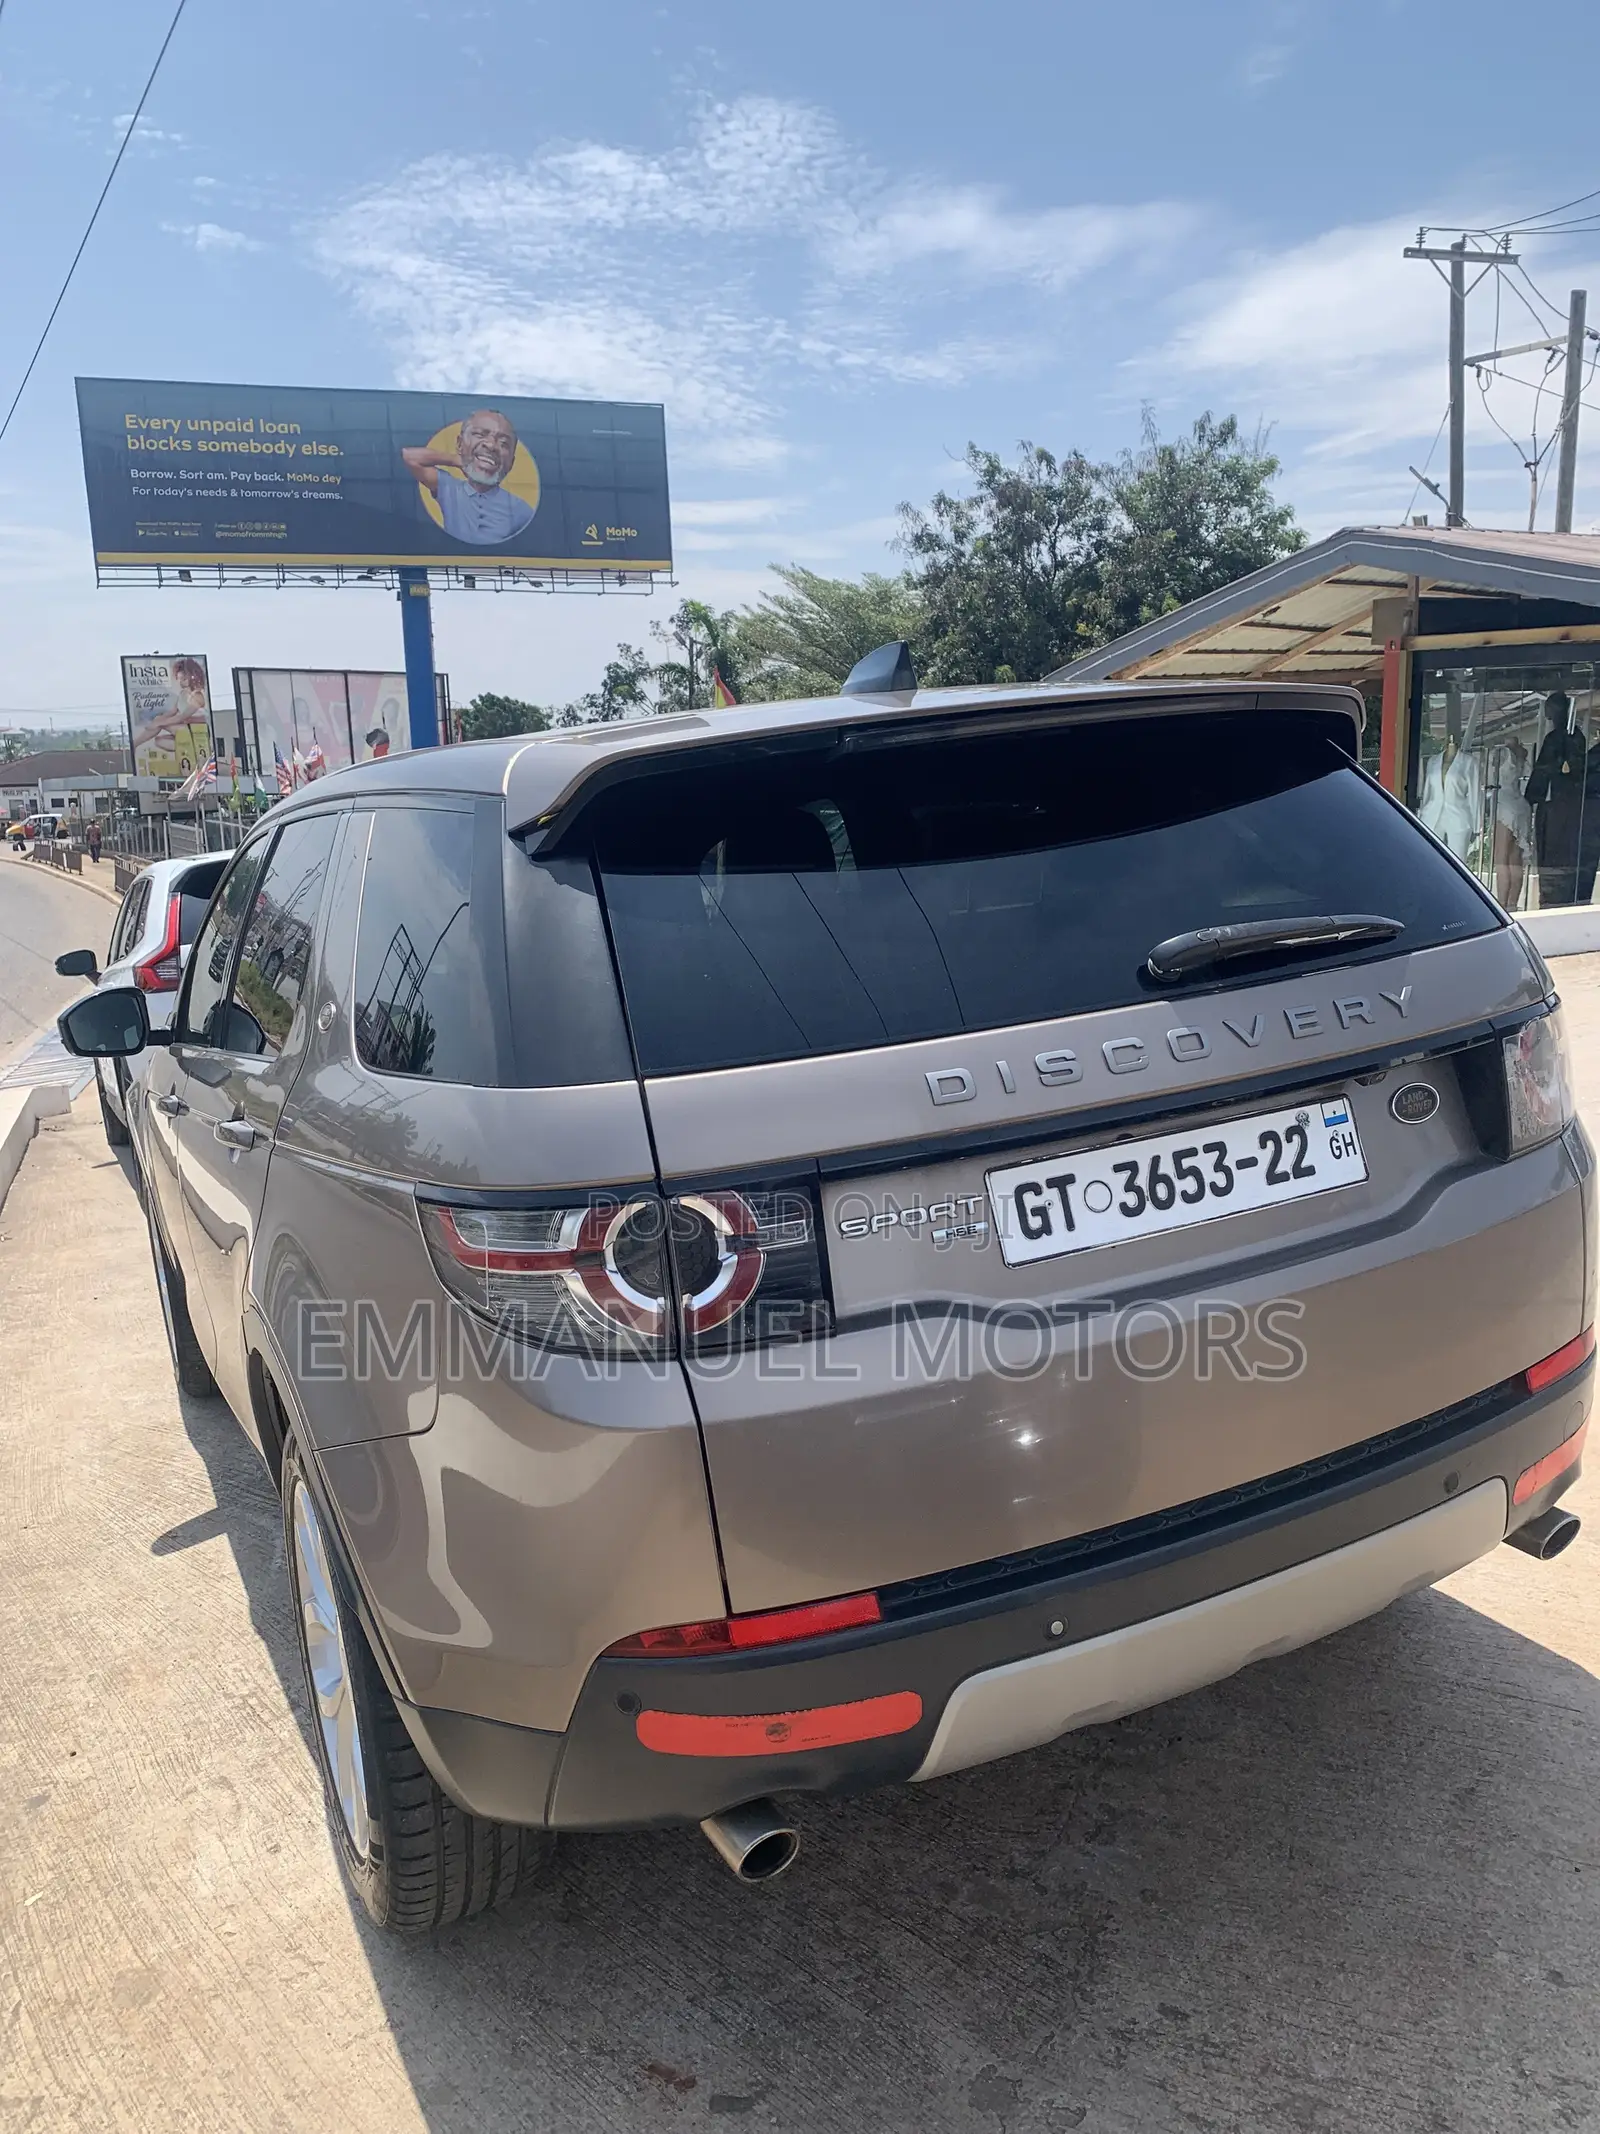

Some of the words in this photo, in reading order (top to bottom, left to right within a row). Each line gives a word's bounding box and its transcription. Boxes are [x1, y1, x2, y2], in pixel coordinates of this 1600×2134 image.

[125, 414, 181, 434] Every
[187, 417, 254, 435] unpaid
[260, 419, 301, 434] loan
[127, 434, 192, 451] blocks
[197, 438, 296, 458] somebody
[302, 441, 344, 456] else.
[130, 469, 177, 479] Borrow.
[180, 470, 204, 480] Sort
[206, 471, 228, 480] am.
[230, 471, 252, 482] Pay
[254, 472, 285, 481] back.
[287, 473, 320, 482] MoMo
[322, 474, 342, 485] dey
[132, 486, 151, 495] For
[154, 487, 193, 498] today's
[195, 488, 228, 497] needs
[230, 488, 238, 497] &
[240, 489, 300, 498] tomorrow's
[302, 490, 343, 500] dreams.
[606, 526, 638, 537] MoMo
[129, 664, 168, 677] Insta
[143, 699, 166, 710] light
[925, 985, 1413, 1106] DISCOVERY
[1402, 1090, 1425, 1105] LAND
[1407, 1099, 1433, 1114] ROVER
[1329, 1131, 1357, 1160] GH
[1013, 1172, 1076, 1241] GT
[1111, 1124, 1317, 1218] 3653-22
[840, 1196, 983, 1239] SPORT
[945, 1224, 978, 1240] HSE
